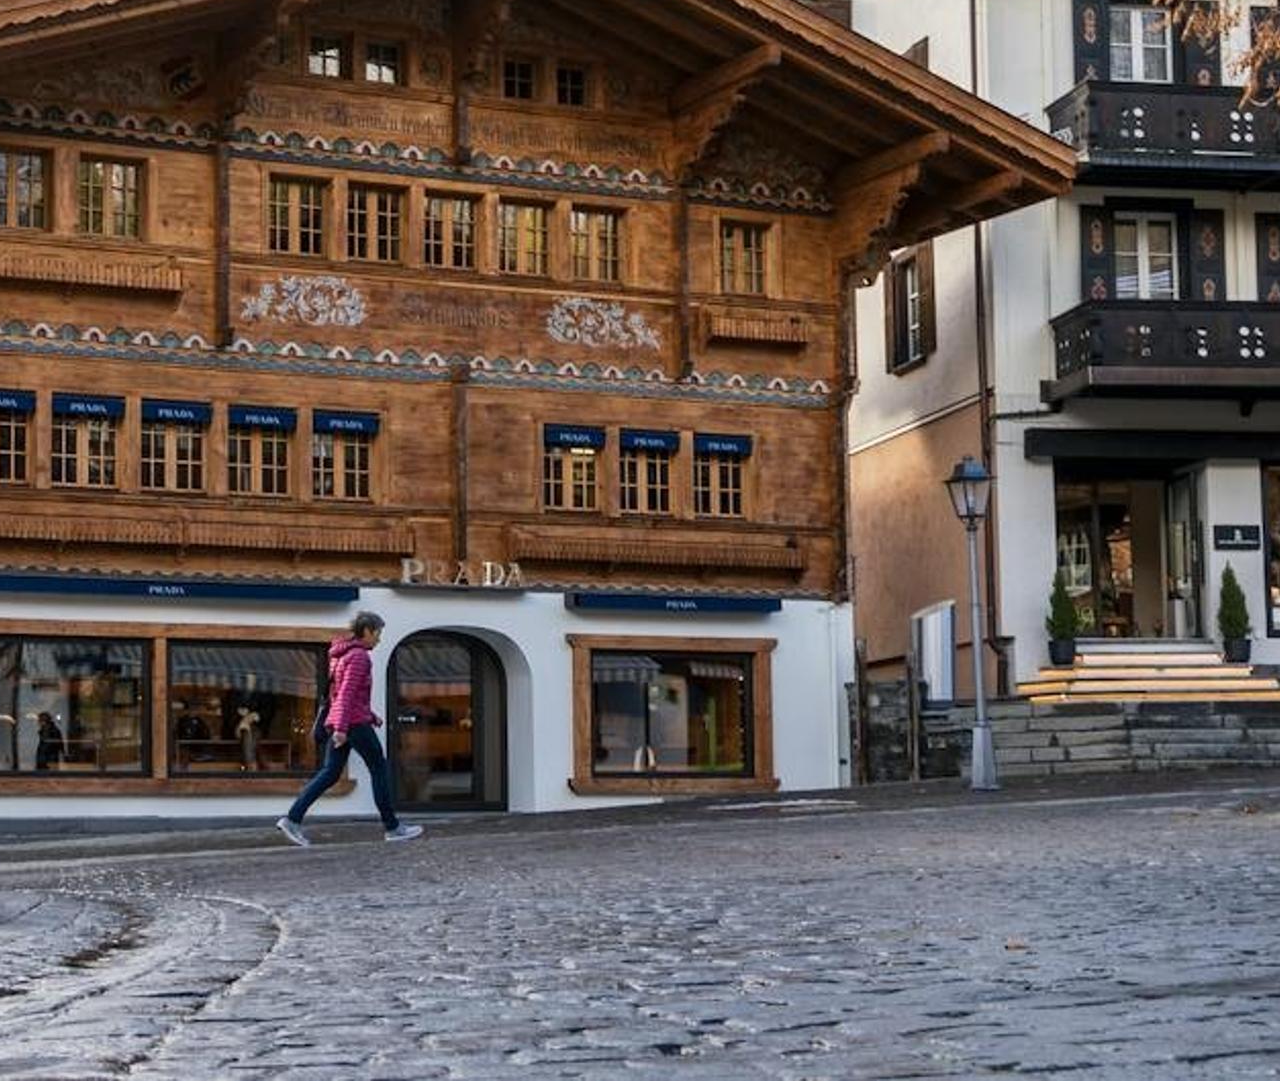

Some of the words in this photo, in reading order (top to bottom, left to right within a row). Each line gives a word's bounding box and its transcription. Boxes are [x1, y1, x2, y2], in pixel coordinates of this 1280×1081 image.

[69, 402, 108, 414] PRADA
[157, 408, 195, 420] PRADA
[244, 414, 281, 425] PRADA
[328, 419, 364, 431] PRADA
[559, 432, 592, 444] PRADA
[633, 436, 666, 448] PRADA
[707, 441, 739, 452] PRADA
[400, 557, 521, 587] PRADA
[148, 584, 186, 595] PRADA
